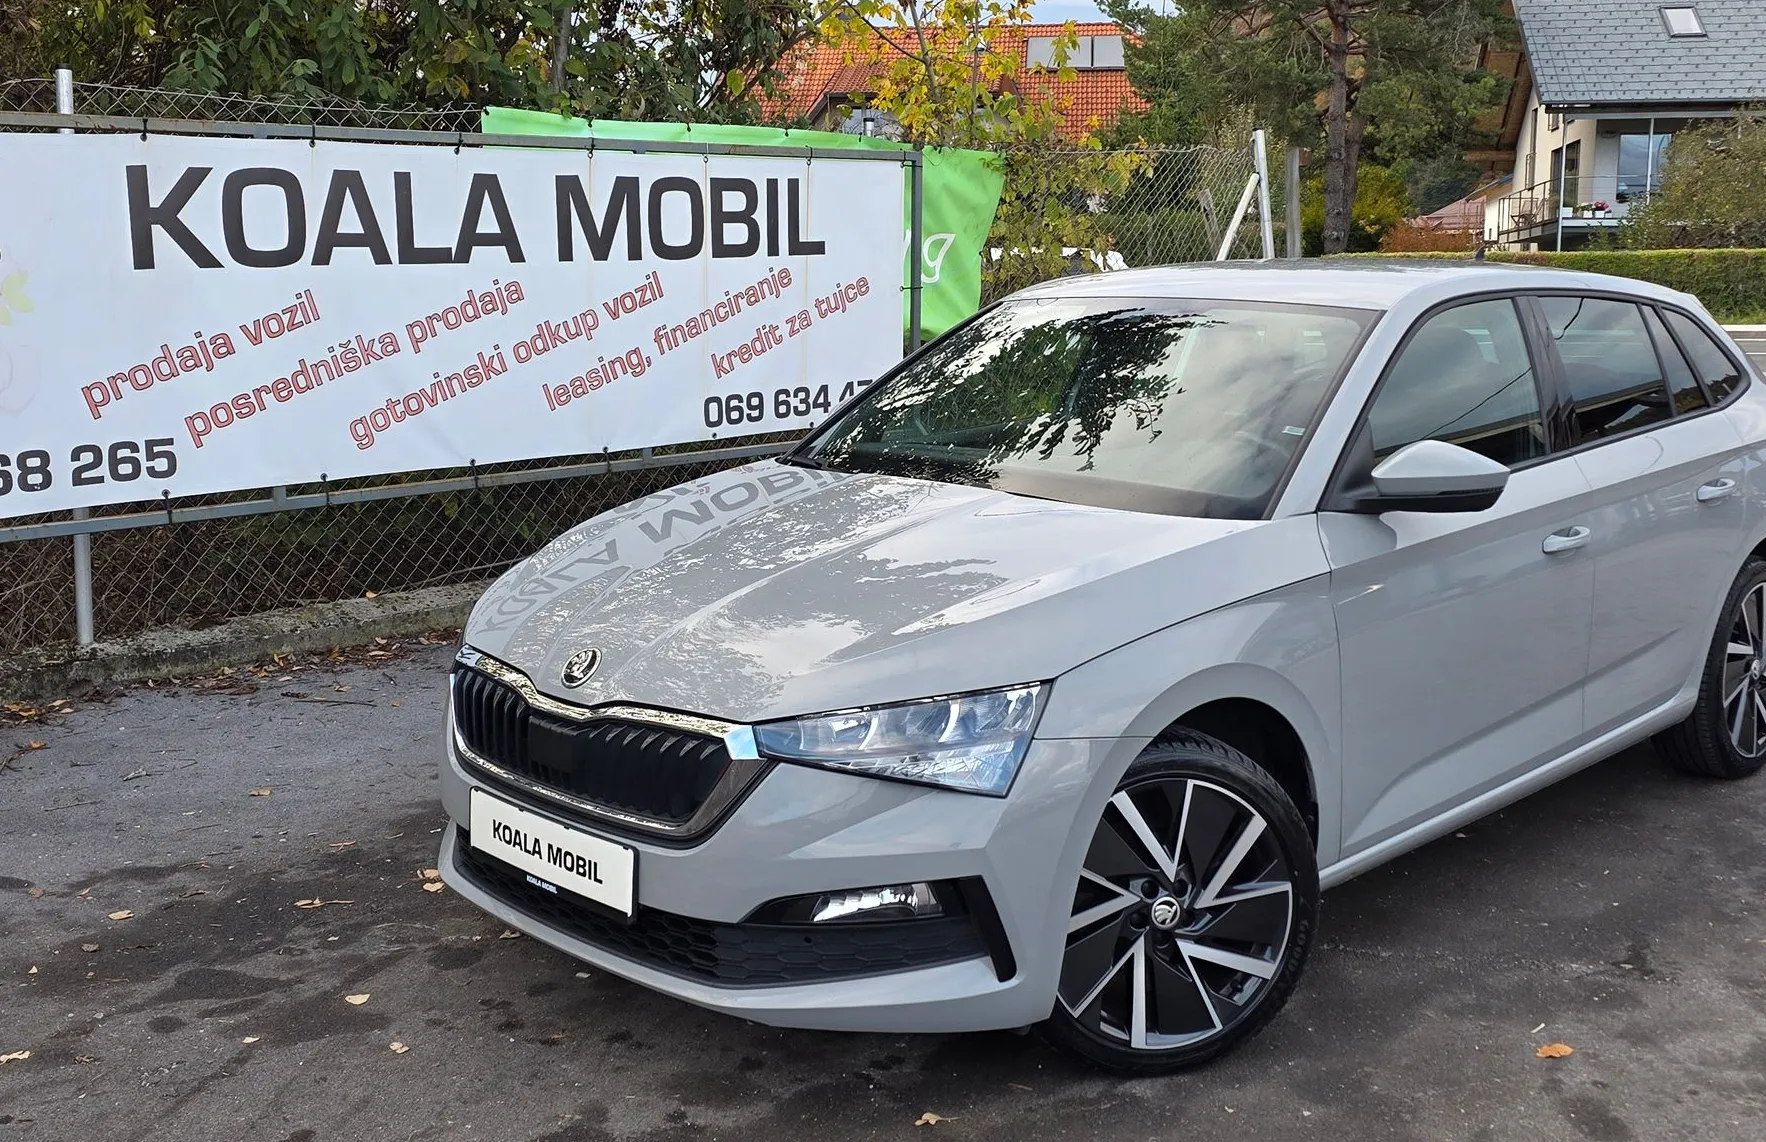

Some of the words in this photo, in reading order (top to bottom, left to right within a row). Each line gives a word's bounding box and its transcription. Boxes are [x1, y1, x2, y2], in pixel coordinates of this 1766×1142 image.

[126, 164, 526, 270] KOALA
[555, 175, 825, 262] MOBIL
[81, 331, 236, 420] prodaja
[239, 289, 320, 346] vozil
[184, 332, 401, 448] posredniška
[405, 278, 525, 353] prodaja
[349, 344, 508, 450] gotovinski
[512, 308, 600, 364] odkup
[603, 271, 664, 320] vozil
[542, 346, 651, 411] leasing,
[654, 266, 792, 355] financiranje
[711, 322, 783, 379] kredit
[785, 308, 812, 337] za
[814, 276, 870, 319] tujce
[704, 392, 764, 428] 069
[774, 384, 831, 419] 634
[71, 438, 177, 487] 265
[493, 819, 543, 859] KOALA
[547, 842, 603, 885] MOBIL
[526, 874, 542, 888] KOALA
[541, 881, 557, 894] MOBIL
